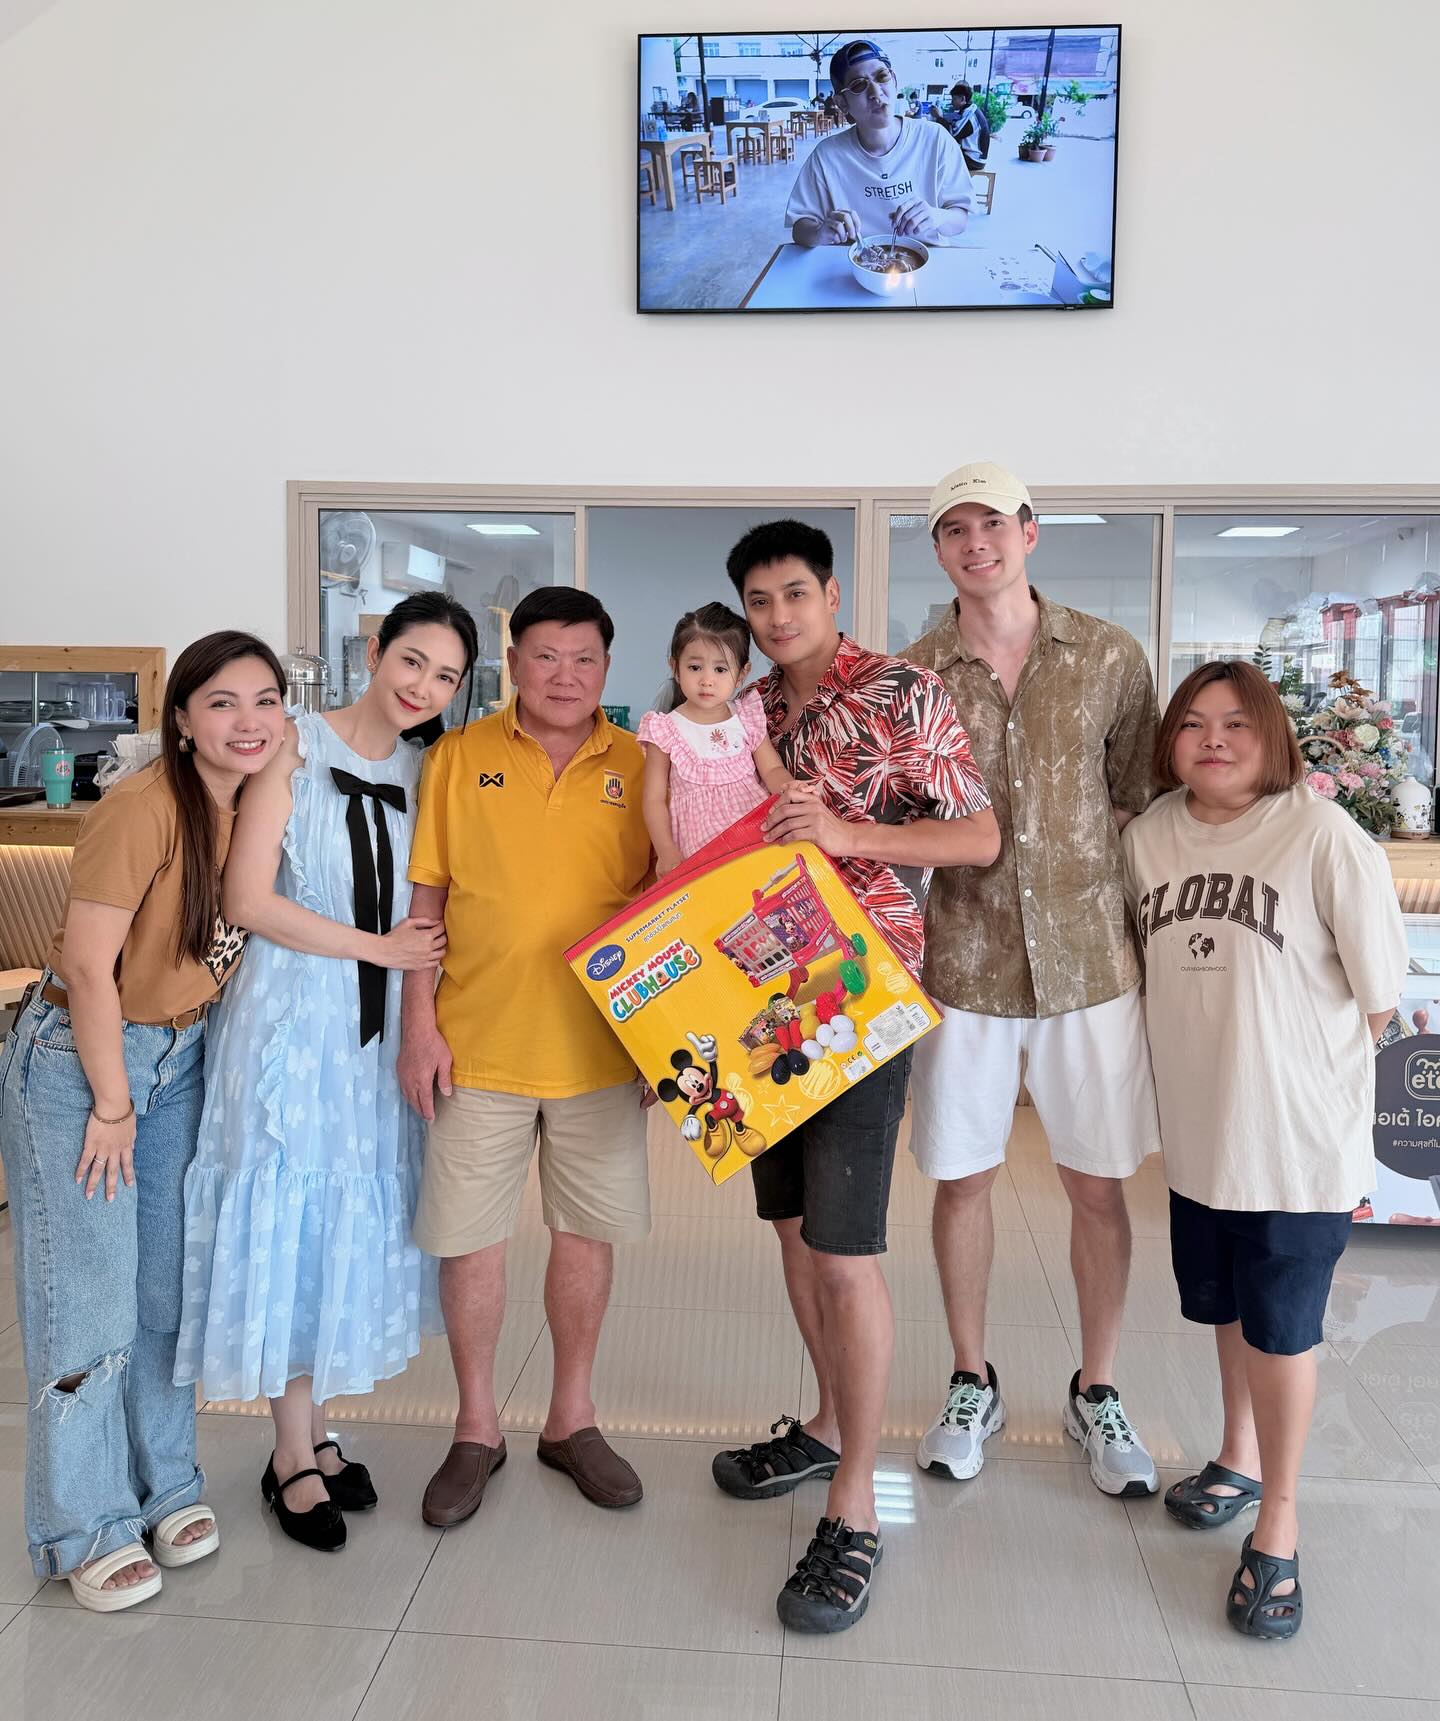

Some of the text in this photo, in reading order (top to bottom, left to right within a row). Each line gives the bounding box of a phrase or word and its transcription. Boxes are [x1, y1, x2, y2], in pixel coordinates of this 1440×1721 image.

[864, 181, 913, 198] STRETSH
[626, 911, 665, 942] SUPERMARKET
[1137, 873, 1284, 953] GLOBAL
[587, 951, 623, 976] Disney
[610, 942, 683, 999] MICKEY MOUSE
